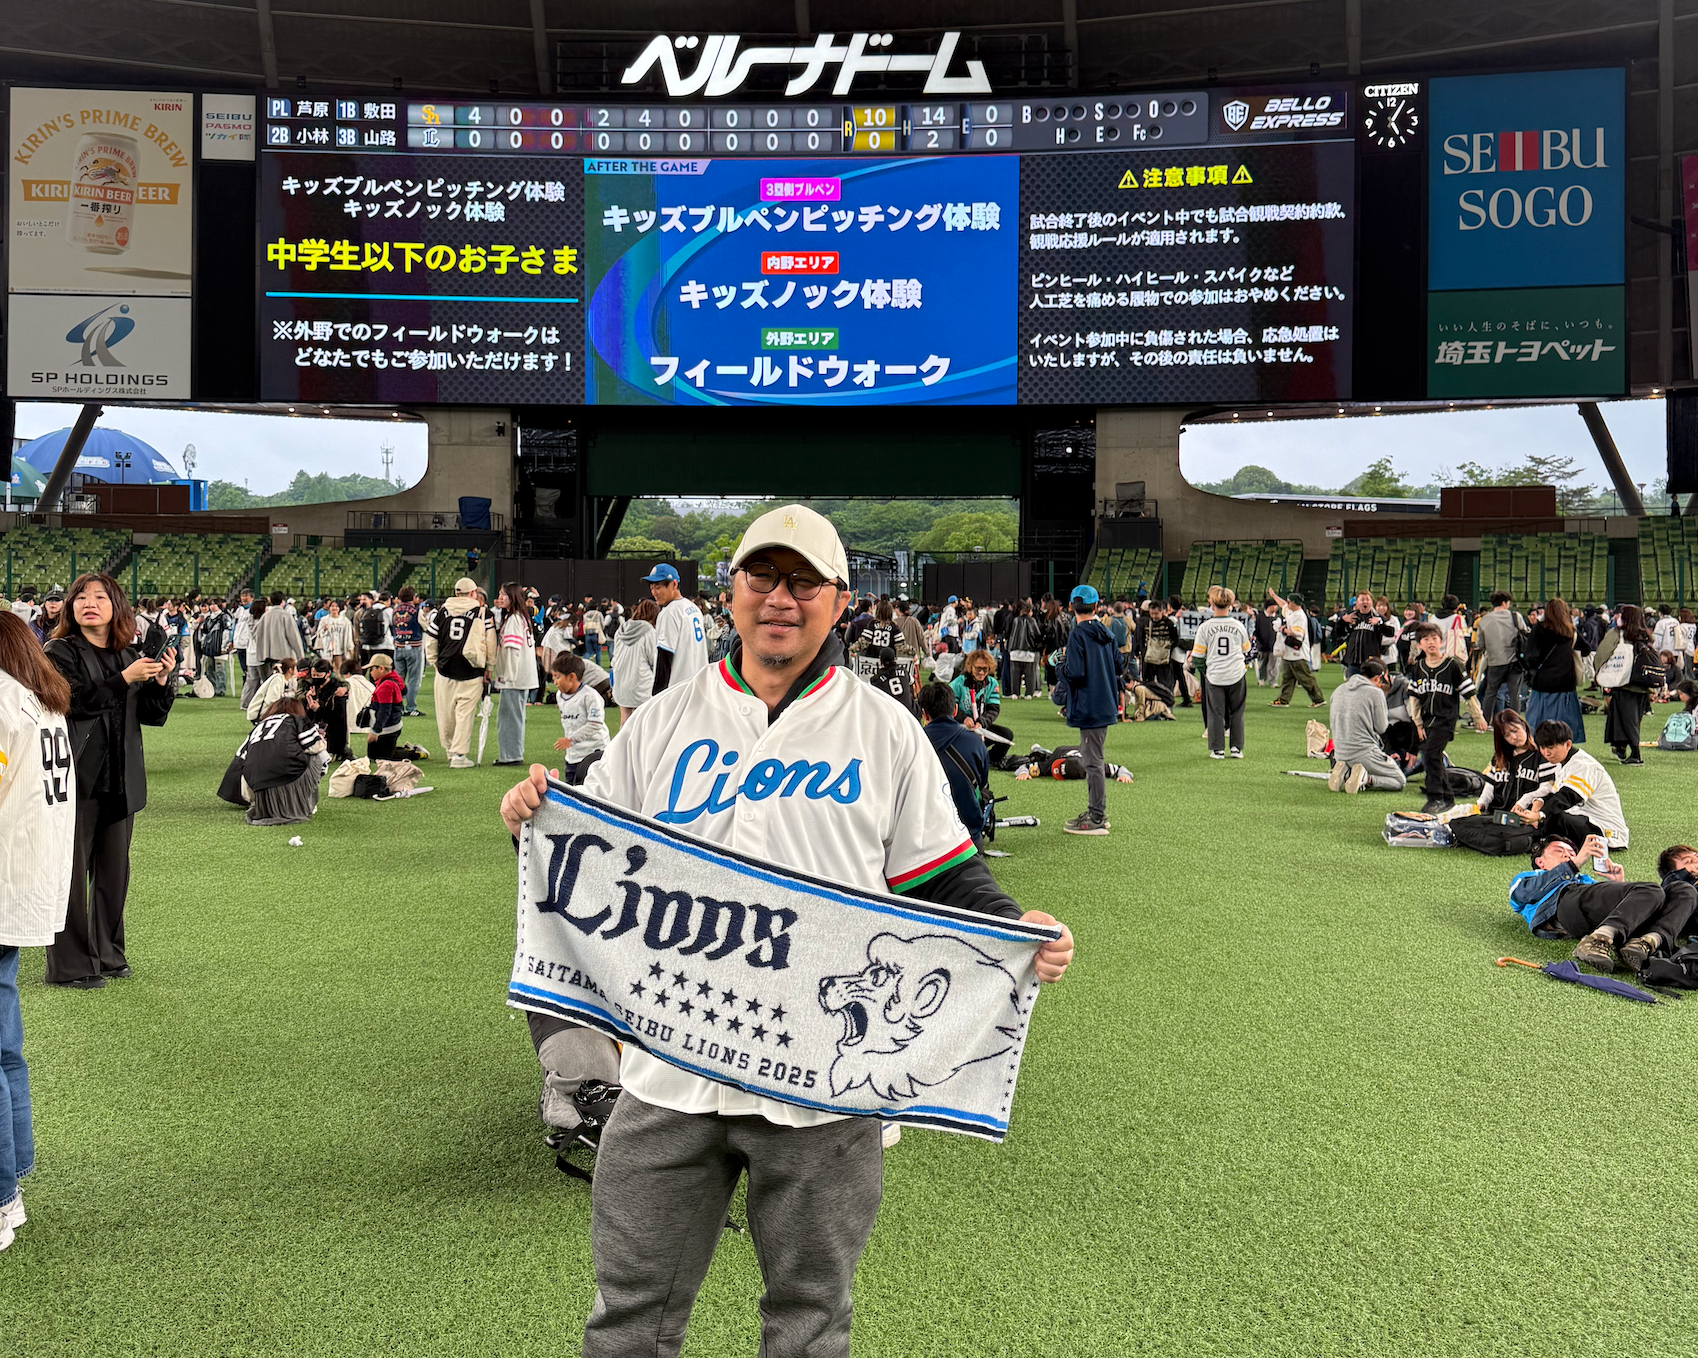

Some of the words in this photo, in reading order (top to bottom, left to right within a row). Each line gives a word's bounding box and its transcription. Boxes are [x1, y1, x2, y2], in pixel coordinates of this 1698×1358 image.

[621, 32, 992, 96] ベルーナドーム
[1364, 82, 1419, 98] CITIZEN
[154, 103, 183, 111] KIRIN
[272, 100, 289, 117] PL
[296, 100, 330, 118] 芦原
[339, 101, 356, 118] 1B
[363, 102, 396, 120] 敷田
[1022, 105, 1031, 124] B
[1094, 102, 1104, 121] S
[1264, 96, 1332, 113] BELLO
[1387, 97, 1397, 107] 12
[206, 112, 252, 121] SEIBU
[468, 106, 481, 124] 4
[509, 107, 523, 125] 0
[550, 107, 564, 126] 0
[597, 108, 610, 127] 2
[638, 109, 651, 127] 4
[678, 109, 692, 127] 0
[725, 109, 738, 127] 0
[766, 109, 779, 127] 0
[806, 109, 819, 127] 0
[863, 108, 887, 126] 10
[922, 106, 945, 125] 14
[985, 105, 998, 124] 0
[1249, 111, 1345, 130] EXPRESS
[1365, 118, 1373, 129] 9
[1410, 116, 1419, 126] 3
[14, 113, 75, 166] KIRIN'S
[79, 109, 142, 132] PRIME
[143, 123, 188, 168] BREW
[271, 127, 289, 144] 2B
[296, 127, 329, 144] 小林
[338, 128, 356, 145] 3B
[364, 130, 396, 146] 山路
[844, 121, 853, 137] R
[903, 120, 911, 136] H
[962, 118, 969, 134] E
[1056, 127, 1065, 144] H
[1096, 125, 1104, 143] E
[1133, 123, 1146, 141] Fc
[468, 130, 481, 148] 0
[509, 130, 523, 148] 0
[550, 131, 564, 149] 0
[597, 131, 610, 150] 0
[638, 132, 651, 150] 0
[678, 132, 692, 151] 0
[725, 132, 738, 151] 0
[766, 132, 779, 151] 0
[806, 131, 819, 150] 0
[868, 131, 881, 149] 0
[926, 130, 939, 148] 2
[985, 128, 998, 147] 0
[1388, 137, 1396, 148] 6
[97, 146, 125, 159] PRIME
[125, 156, 137, 178] BREW
[1443, 127, 1610, 175] SEIBU
[587, 162, 629, 173] AFTER
[631, 162, 657, 173] THE
[660, 162, 698, 173] GAME
[1142, 165, 1228, 188] 注意事項
[31, 184, 68, 199] KIRI
[137, 186, 171, 201] EER
[74, 185, 104, 198] KIRIN
[106, 189, 132, 202] BEER
[281, 176, 567, 203] キッズブルペンピッチング体験
[766, 182, 835, 198] 3塁側ブルペン
[80, 202, 122, 215] 一番搾り
[342, 198, 506, 222] キッズノック体験
[602, 202, 1001, 233] キッズブルペンピッチング体験
[1029, 202, 1347, 230] 試合終了後のイベント中でも試合観戦契約約款、
[1459, 185, 1593, 230] SOGO
[1029, 228, 1240, 250] 観戦応援ルールが適用されます。
[266, 237, 579, 275] 中学生以下のお子さま
[766, 256, 835, 270] 内野エリア
[1031, 265, 1295, 288] ピンヒール・ハイヒール・スパイクなど
[679, 279, 922, 309] キッズノック体験
[1029, 285, 1346, 309] 人工芝を痛める履物での参加はおやめください。
[1438, 318, 1613, 332] いい人生のそばに、いつも。
[766, 331, 835, 346] 外野エリア
[1029, 326, 1340, 348] イベント参加中に負傷された場合、応急処置は
[294, 348, 573, 372] どなたでもご参加いただけます！
[1029, 346, 1314, 368] いたしますが、その後の責任は負いません。
[1434, 338, 1616, 365] 埼玉トヨペット
[31, 371, 58, 383] SP
[65, 373, 168, 386] HOLDINGS
[649, 354, 951, 387] フィールドウォーク
[52, 386, 147, 395] SPホールディングス株式会社
[783, 515, 797, 530] LA
[449, 618, 466, 640] 6
[693, 617, 704, 643] 6
[872, 630, 890, 647] 23
[1217, 637, 1230, 656] 9
[888, 677, 904, 695] 6
[249, 720, 285, 744] 47
[652, 738, 863, 824] Lions
[535, 833, 798, 971] Lions
[682, 1032, 750, 1070] LIONS
[758, 1058, 818, 1089] 2025
